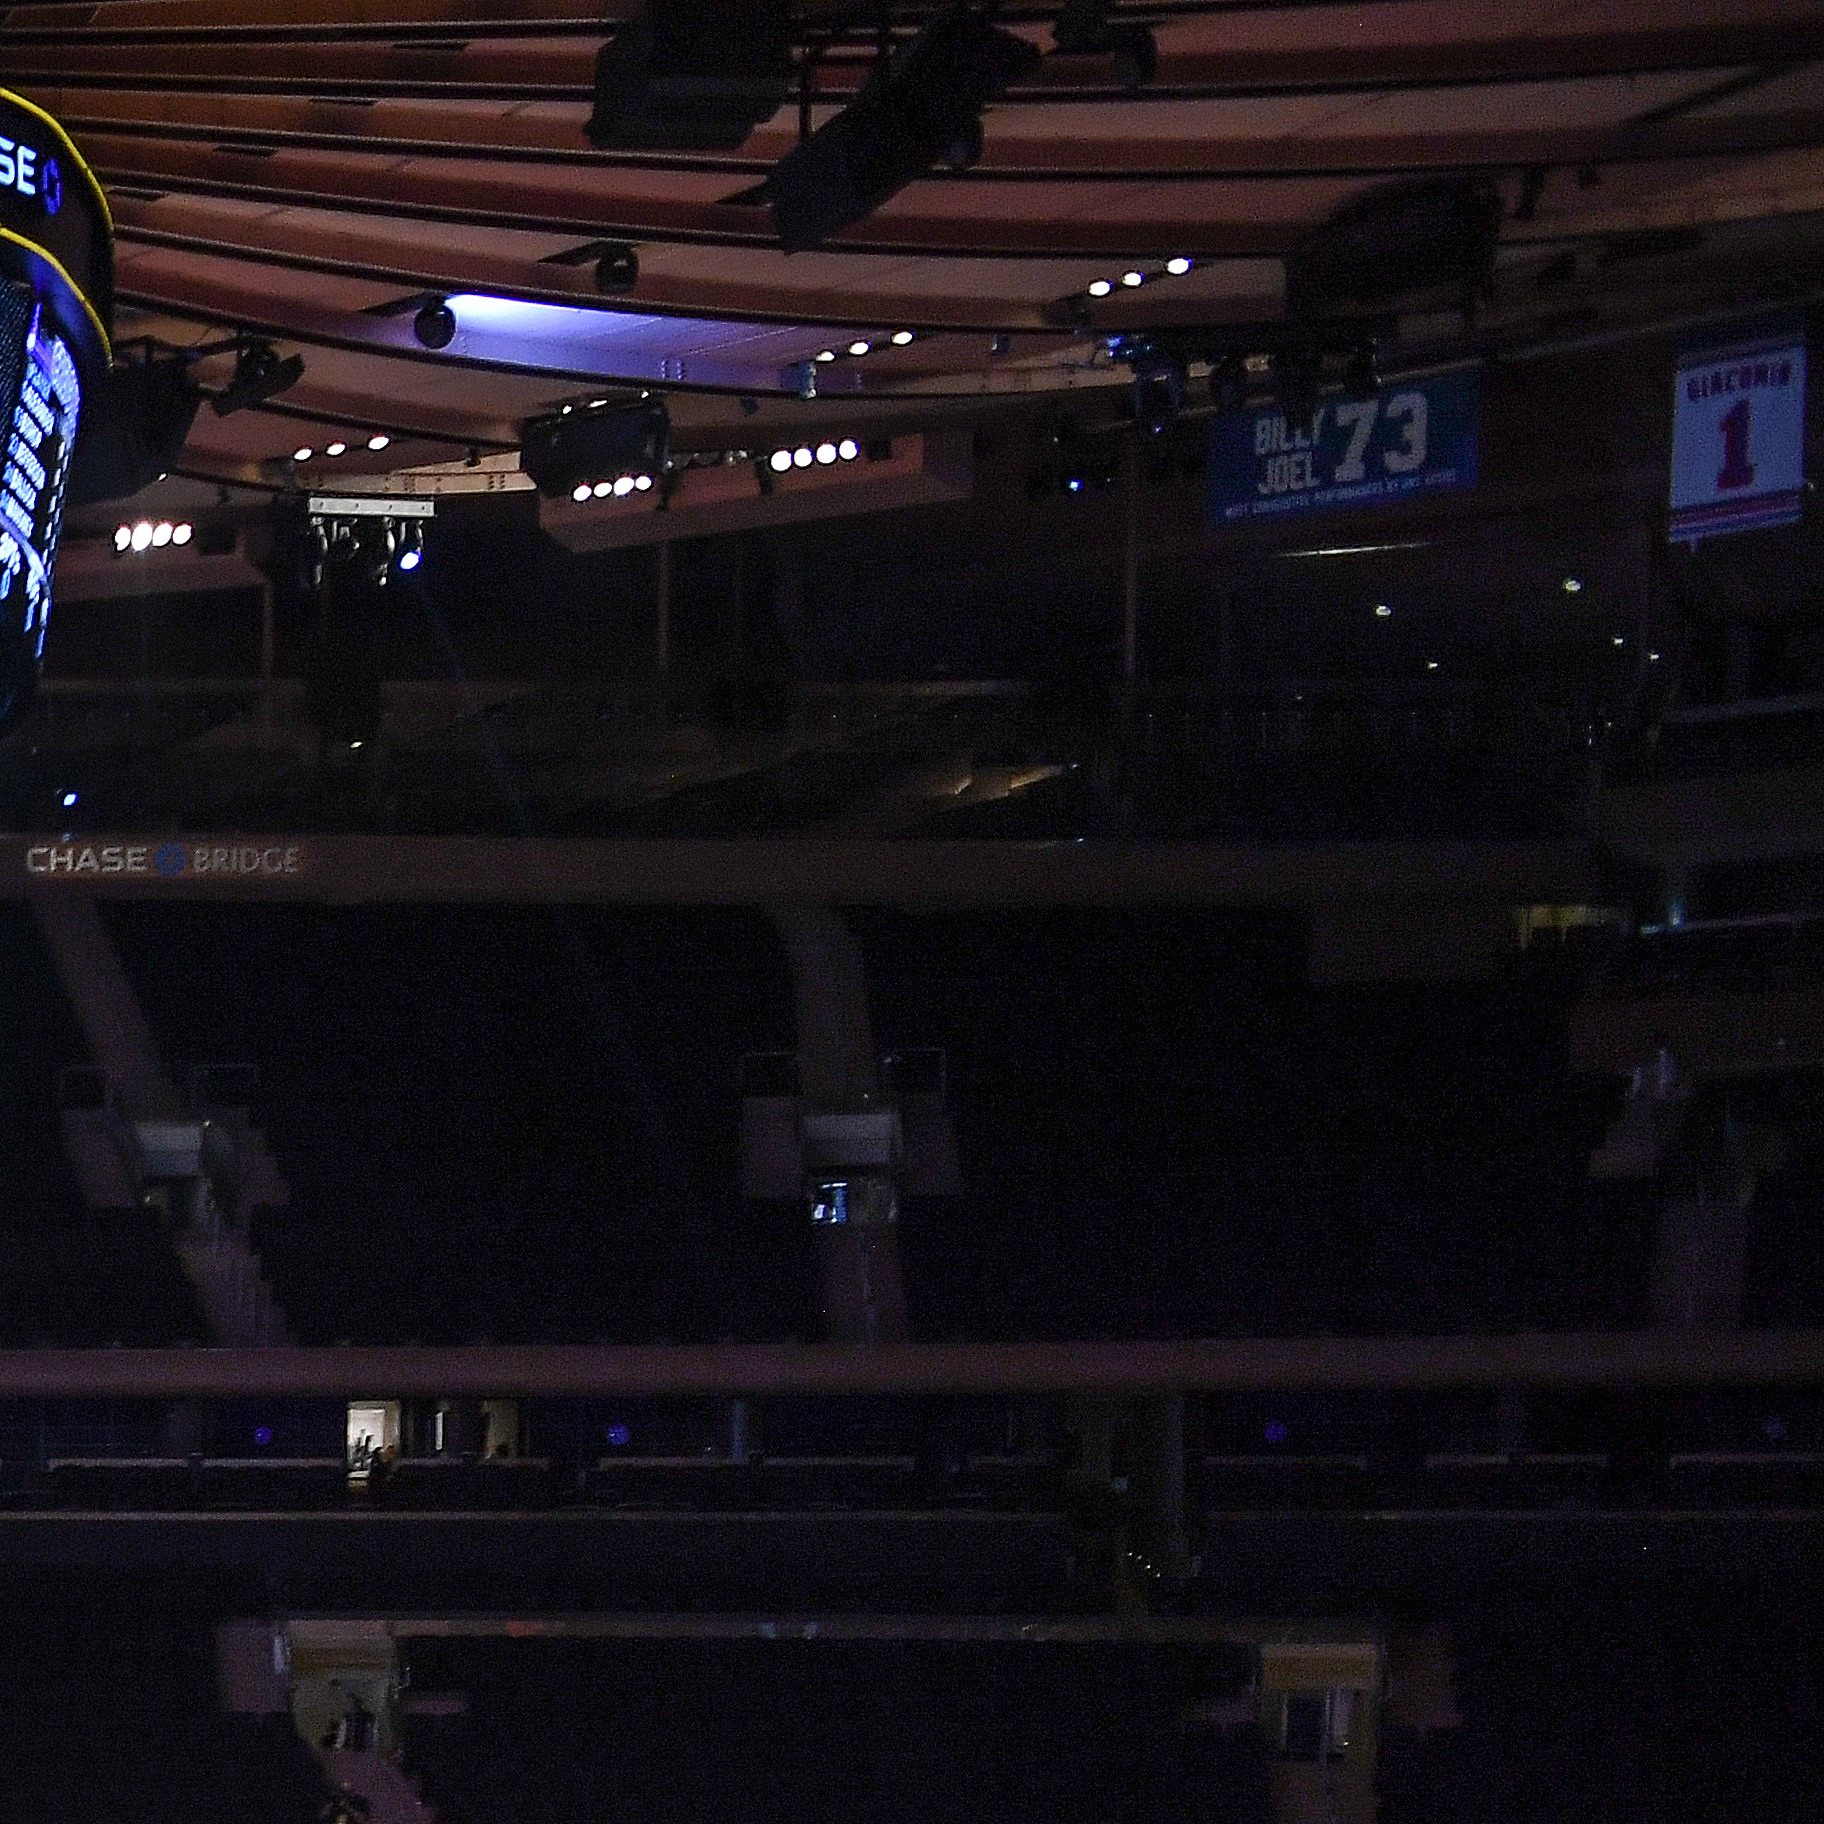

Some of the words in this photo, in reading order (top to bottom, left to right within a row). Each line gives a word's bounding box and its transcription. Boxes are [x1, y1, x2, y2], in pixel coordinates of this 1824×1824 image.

[1334, 391, 1429, 482] 73
[1716, 398, 1756, 491] 1
[25, 846, 149, 873] CHASE
[192, 847, 301, 874] BRIDGE
